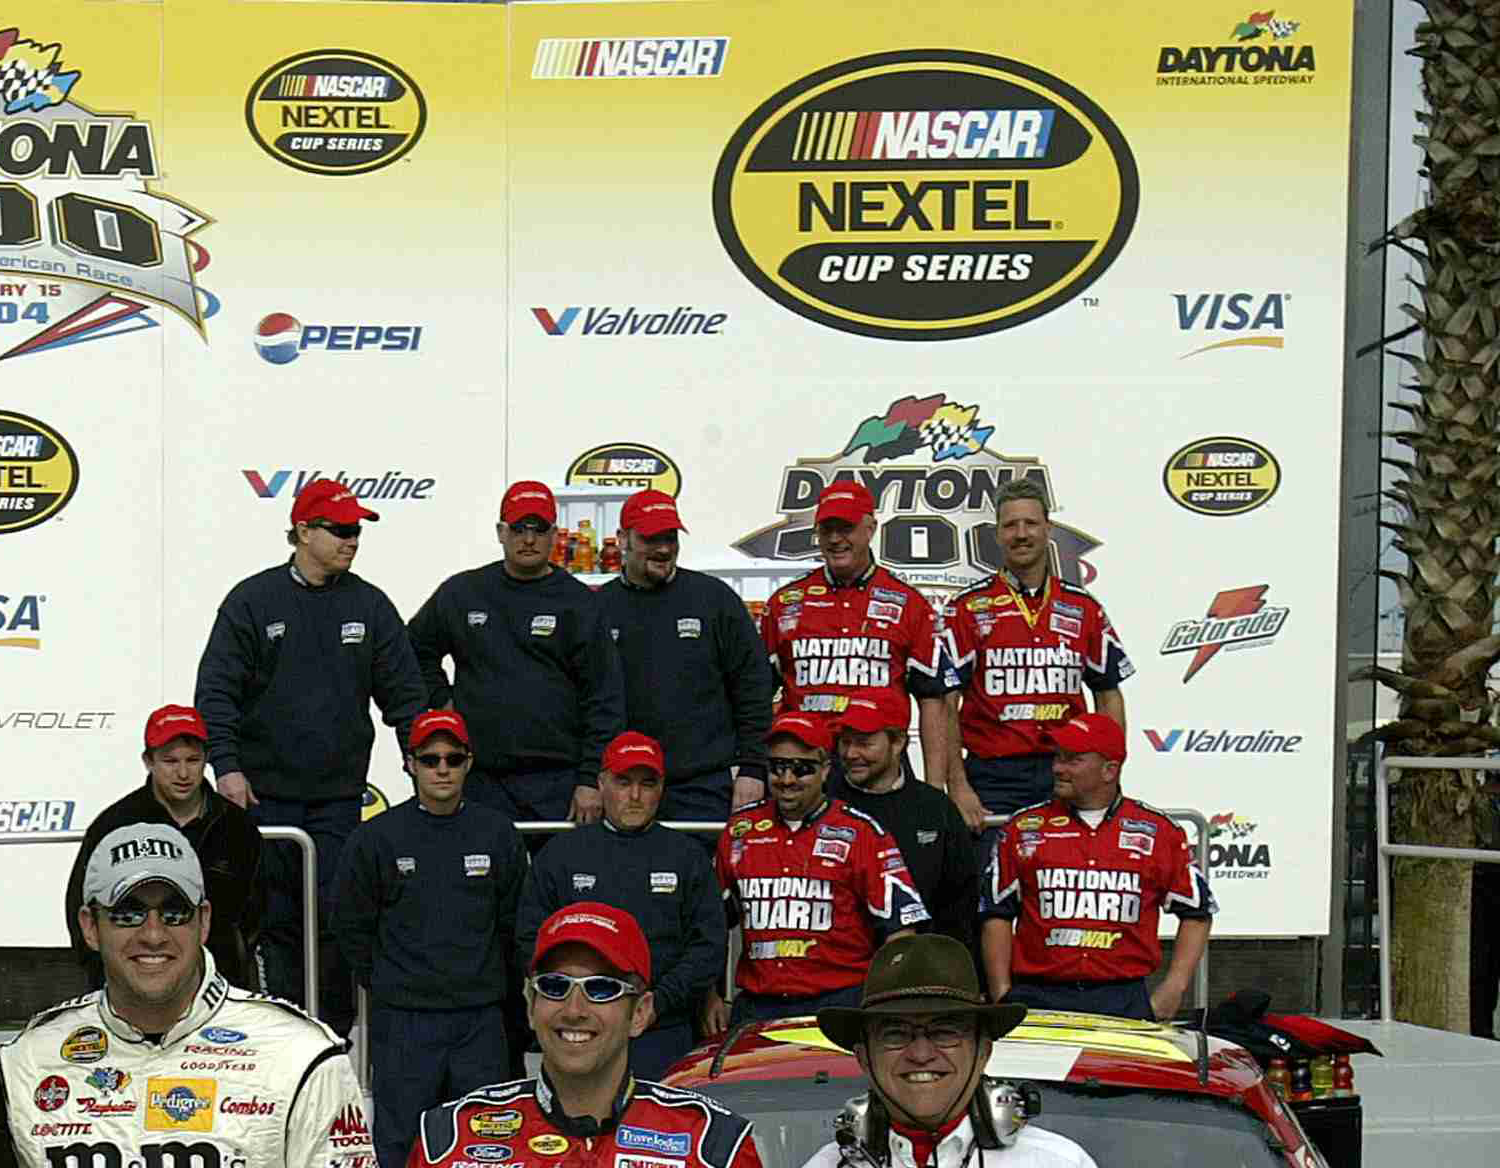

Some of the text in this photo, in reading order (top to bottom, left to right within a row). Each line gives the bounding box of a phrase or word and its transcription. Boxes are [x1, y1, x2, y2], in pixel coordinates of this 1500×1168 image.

[593, 39, 718, 75] NASCAR
[1156, 45, 1315, 74] DAYTONA
[312, 75, 390, 97] NASCAR
[1156, 73, 1314, 86] INTERNATIONAL SPEEDWAY
[281, 104, 393, 129] NEXTEL
[290, 136, 384, 152] CUP SERIES
[873, 110, 1044, 159] NASCAR
[798, 179, 1052, 232] NEXTEL
[73, 262, 134, 287] Race
[820, 253, 1034, 282] CUP SERIES
[37, 283, 62, 297] 15
[581, 306, 726, 336] Valvoline
[1172, 293, 1287, 331] VISA
[300, 326, 422, 352] PEPSI
[609, 456, 658, 474] NASCAR
[1206, 451, 1254, 468] NASCAR
[293, 471, 436, 501] Vlvoline
[1186, 472, 1258, 487] NEXTEL
[1191, 491, 1253, 502] CUP SERIES
[1168, 611, 1285, 650] Gatorade
[792, 637, 891, 659] NATIONAL
[985, 648, 1083, 669] NATIONAL
[794, 658, 890, 687] GUARD
[986, 667, 1083, 696] GUARD
[800, 694, 848, 713] SUBW
[1000, 703, 1071, 721] SUBWAY
[1183, 729, 1302, 753] Valvoline
[1037, 868, 1142, 893] NATIONAL
[1214, 868, 1271, 880] SPEEDWAY
[737, 877, 834, 900] NATIONAL
[740, 899, 833, 931] GUARD
[1039, 891, 1140, 923] GUARD
[750, 940, 817, 959] SUBWAY
[1045, 930, 1121, 950] SUBWAY
[180, 1061, 256, 1073] GOODYEAR
[220, 1096, 276, 1116] Combos
